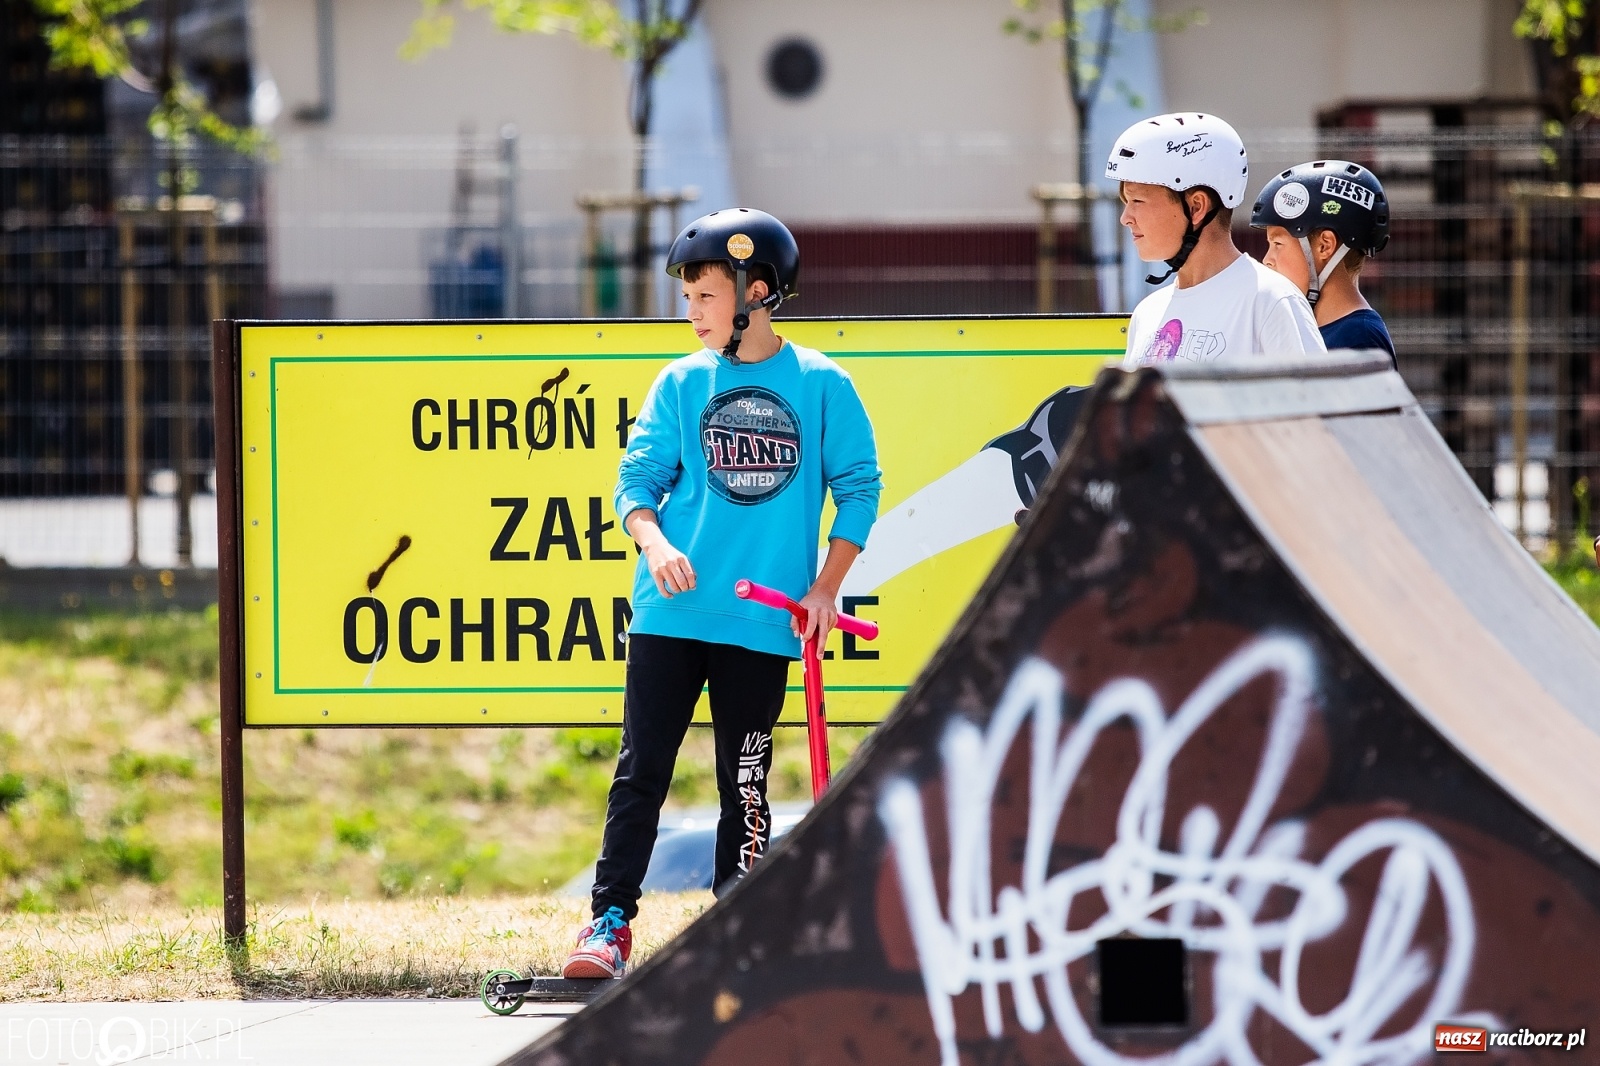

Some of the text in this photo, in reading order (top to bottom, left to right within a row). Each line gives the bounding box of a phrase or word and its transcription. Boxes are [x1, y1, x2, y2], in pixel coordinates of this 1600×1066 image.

[1326, 177, 1372, 207] WEST
[737, 400, 756, 409] TOM
[746, 408, 773, 417] TAILOR
[412, 384, 595, 450] CHROŃ
[716, 412, 779, 429] TOGETHER
[704, 428, 798, 469] STAND
[727, 472, 775, 487] UNITED
[489, 496, 641, 562] ZAŁ
